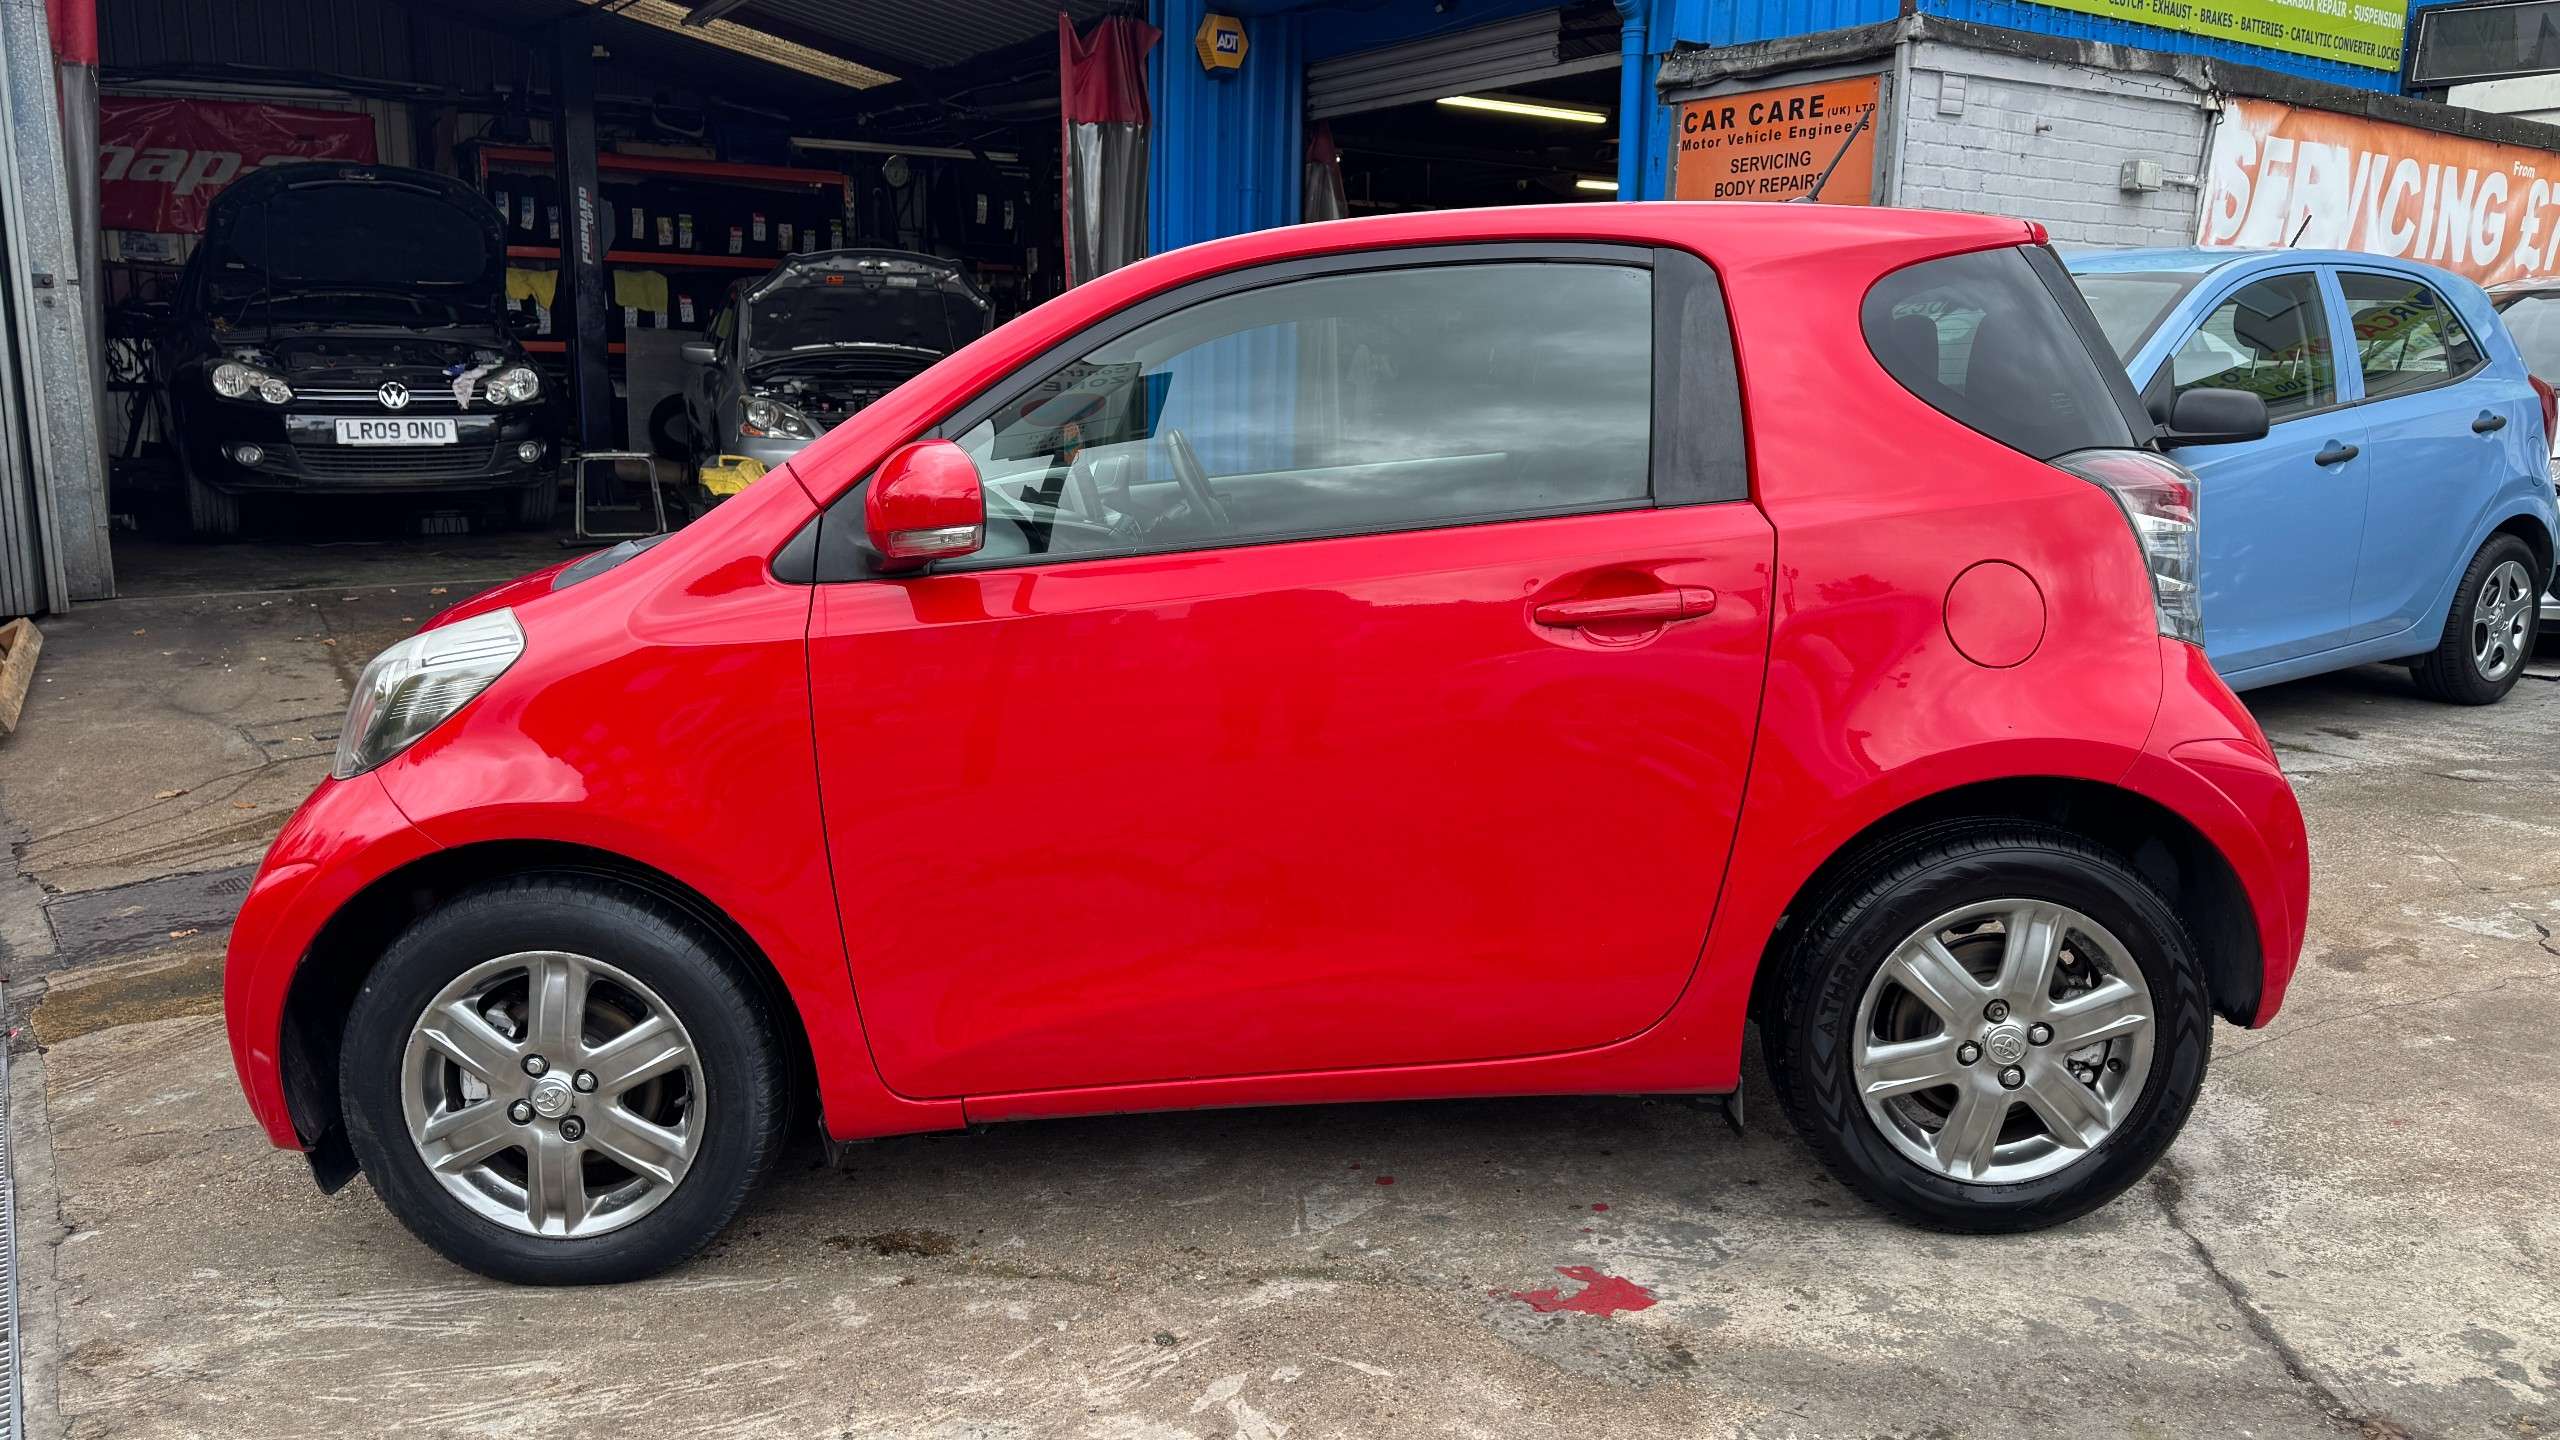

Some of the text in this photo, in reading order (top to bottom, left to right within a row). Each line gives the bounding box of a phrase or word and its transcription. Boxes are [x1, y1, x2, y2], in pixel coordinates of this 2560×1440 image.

[2316, 0, 2347, 18] REPAIR
[2353, 4, 2403, 30] SUSPENSION
[1216, 33, 1239, 51] ADT
[2152, 0, 2193, 20] EXHAUST
[2199, 8, 2233, 28] BRAKES
[2240, 16, 2284, 39] BATTERIES
[2290, 26, 2332, 49] CATALYTIC
[2333, 35, 2376, 57] CONVERTER
[2377, 44, 2400, 62] LOCKS
[1683, 94, 1876, 134] CAR CARE (UK) LTD
[1681, 120, 1870, 152] Motor Vehicle Enginees
[1729, 150, 1812, 174] SERVICING
[2512, 160, 2536, 179] From
[1714, 179, 1756, 198] BODY
[345, 422, 400, 439] LR09
